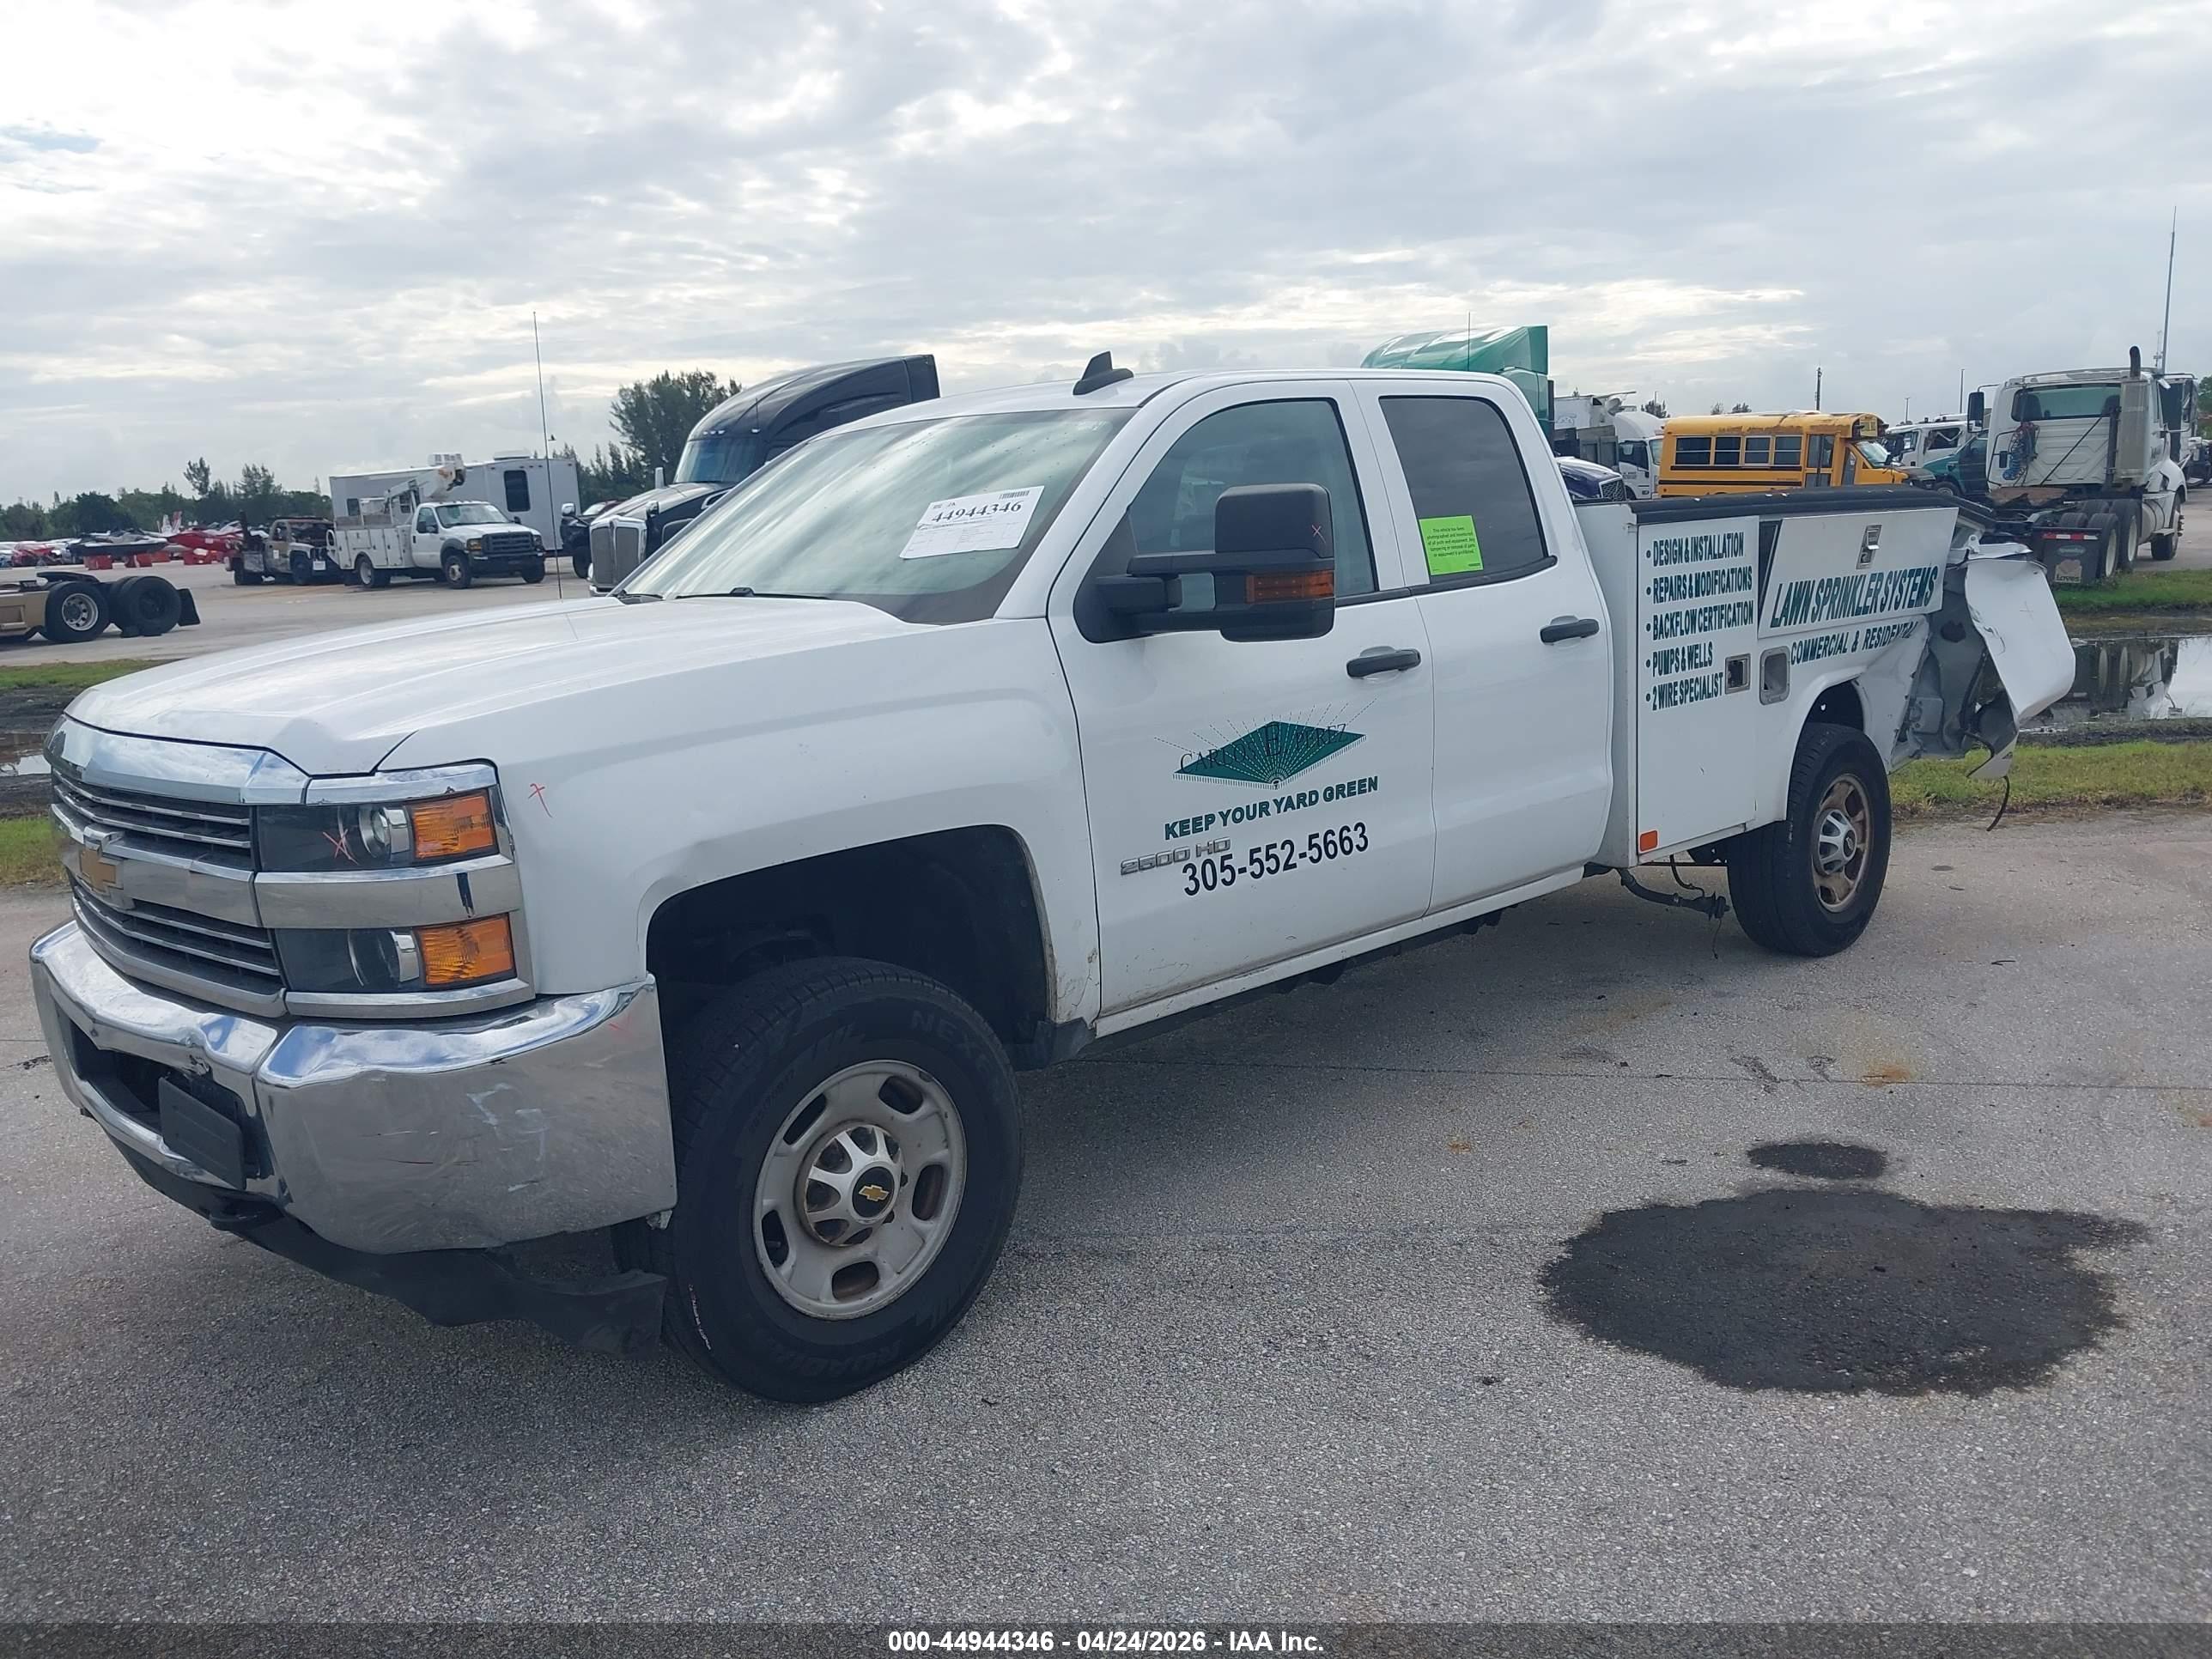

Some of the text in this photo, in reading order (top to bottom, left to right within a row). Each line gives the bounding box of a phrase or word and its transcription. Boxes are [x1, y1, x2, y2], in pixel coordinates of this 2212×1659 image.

[932, 501, 1024, 523] 44944346
[1653, 532, 1744, 567] DESIGN & INSTALLATION
[1653, 566, 1752, 604] REPAIRS & MODIFICATIONS
[1770, 566, 1938, 629] LAWN SPRINKLER SYSTEMS
[1653, 600, 1753, 641] BACKFLOW CERTIFICATION
[1652, 641, 1713, 678] PUMPS & WELLS
[1790, 631, 1849, 665] COMMERCIAL
[1850, 630, 1860, 653] &
[1652, 672, 1723, 711] 2 WIRE SPECIALIST
[1180, 741, 1257, 773] CARLOS
[1295, 723, 1346, 750] PEREZ
[1164, 775, 1379, 841] KEEP YOUR YARD GREEN
[1120, 836, 1231, 876] 2500 HD
[1182, 822, 1370, 896] 305-552-5663
